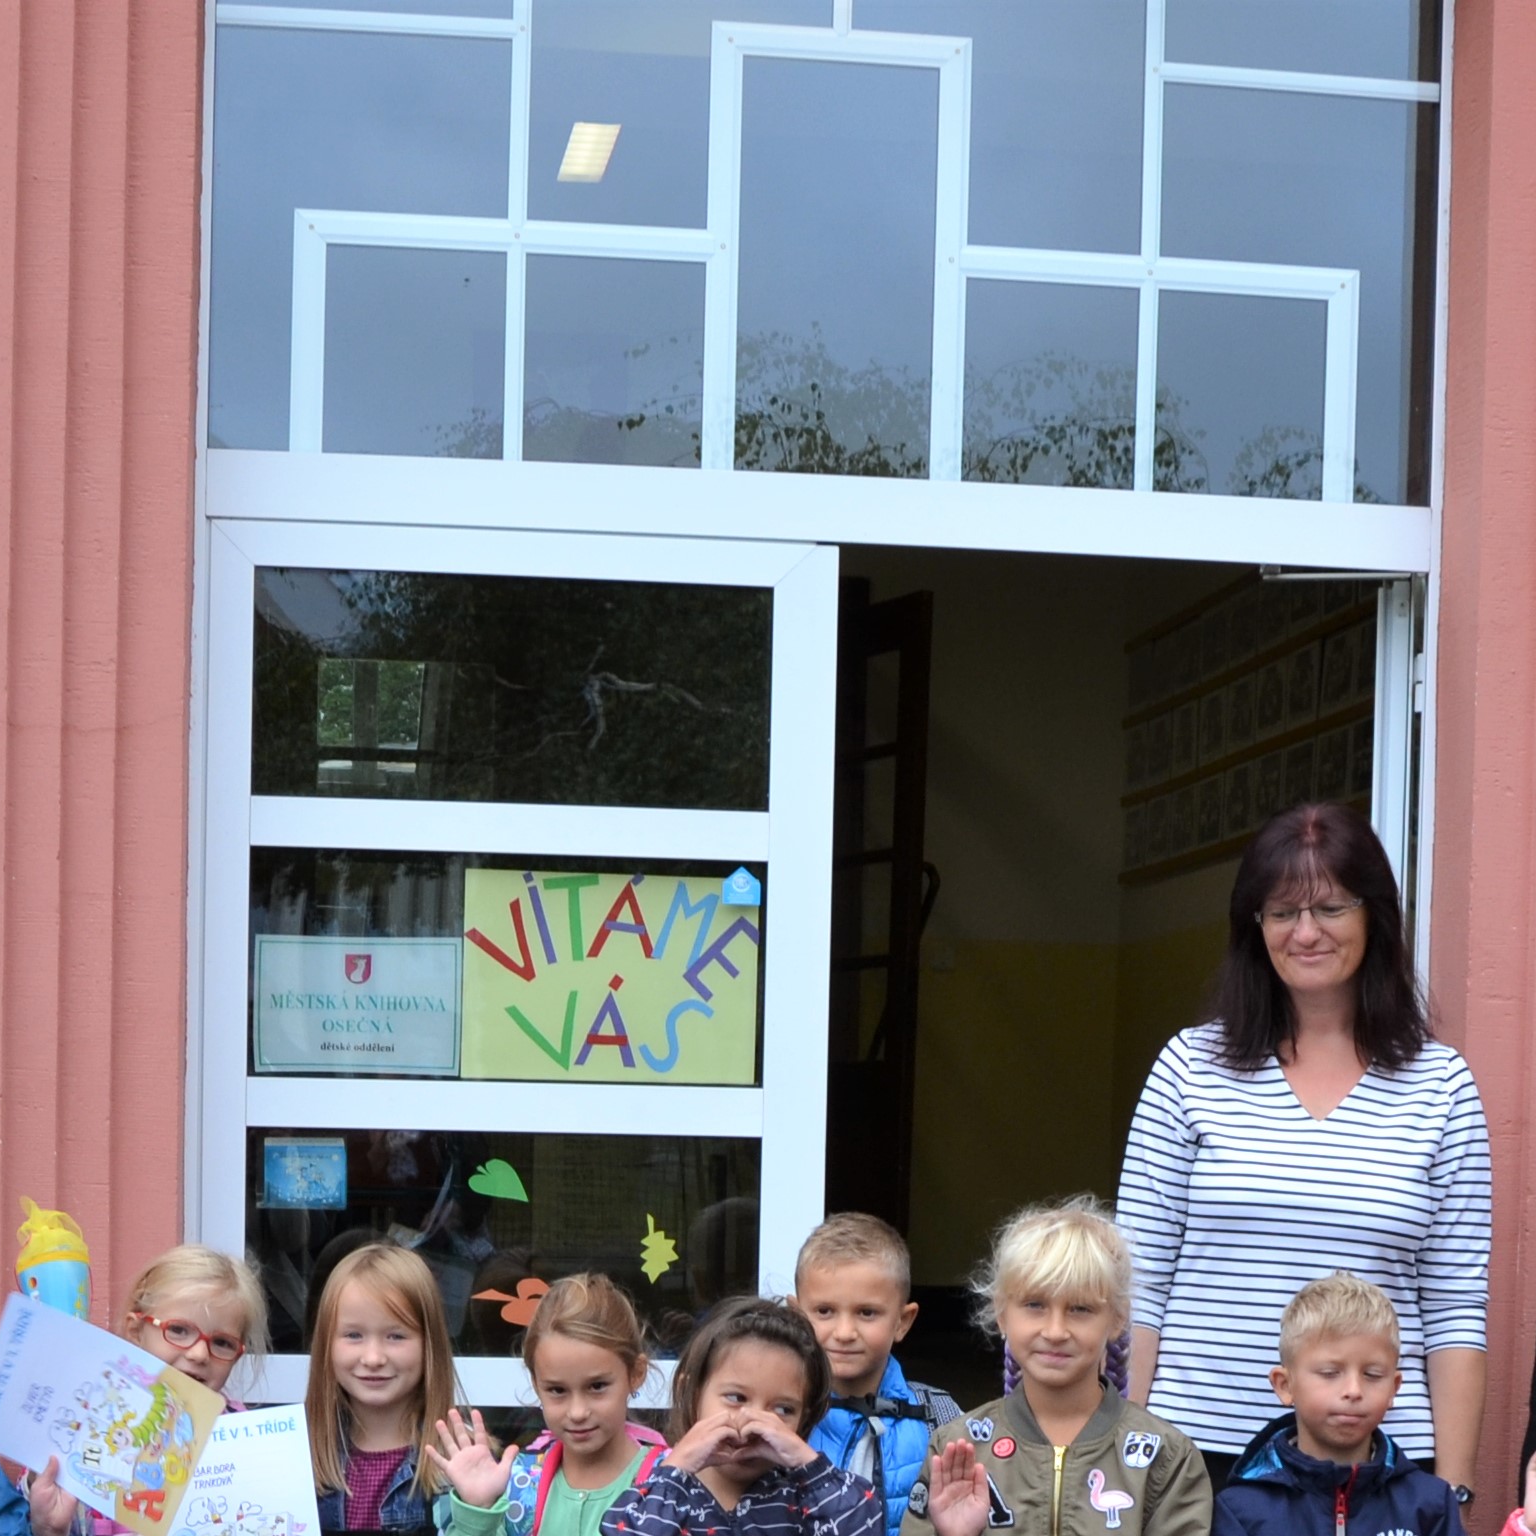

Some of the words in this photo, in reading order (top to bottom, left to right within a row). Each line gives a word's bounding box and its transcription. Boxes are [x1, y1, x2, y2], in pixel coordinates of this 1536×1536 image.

[464, 871, 760, 1002] VÍTÁME
[269, 991, 349, 1010] MĚSTSKÁ
[355, 993, 446, 1012] KNIHOVNA
[321, 1016, 394, 1034] OSEČNÁ
[504, 974, 714, 1073] VÁS
[320, 1042, 351, 1051] dětské
[353, 1042, 395, 1053] oddělení
[228, 1428, 239, 1440] V
[255, 1416, 296, 1436] TŘÍDĚ
